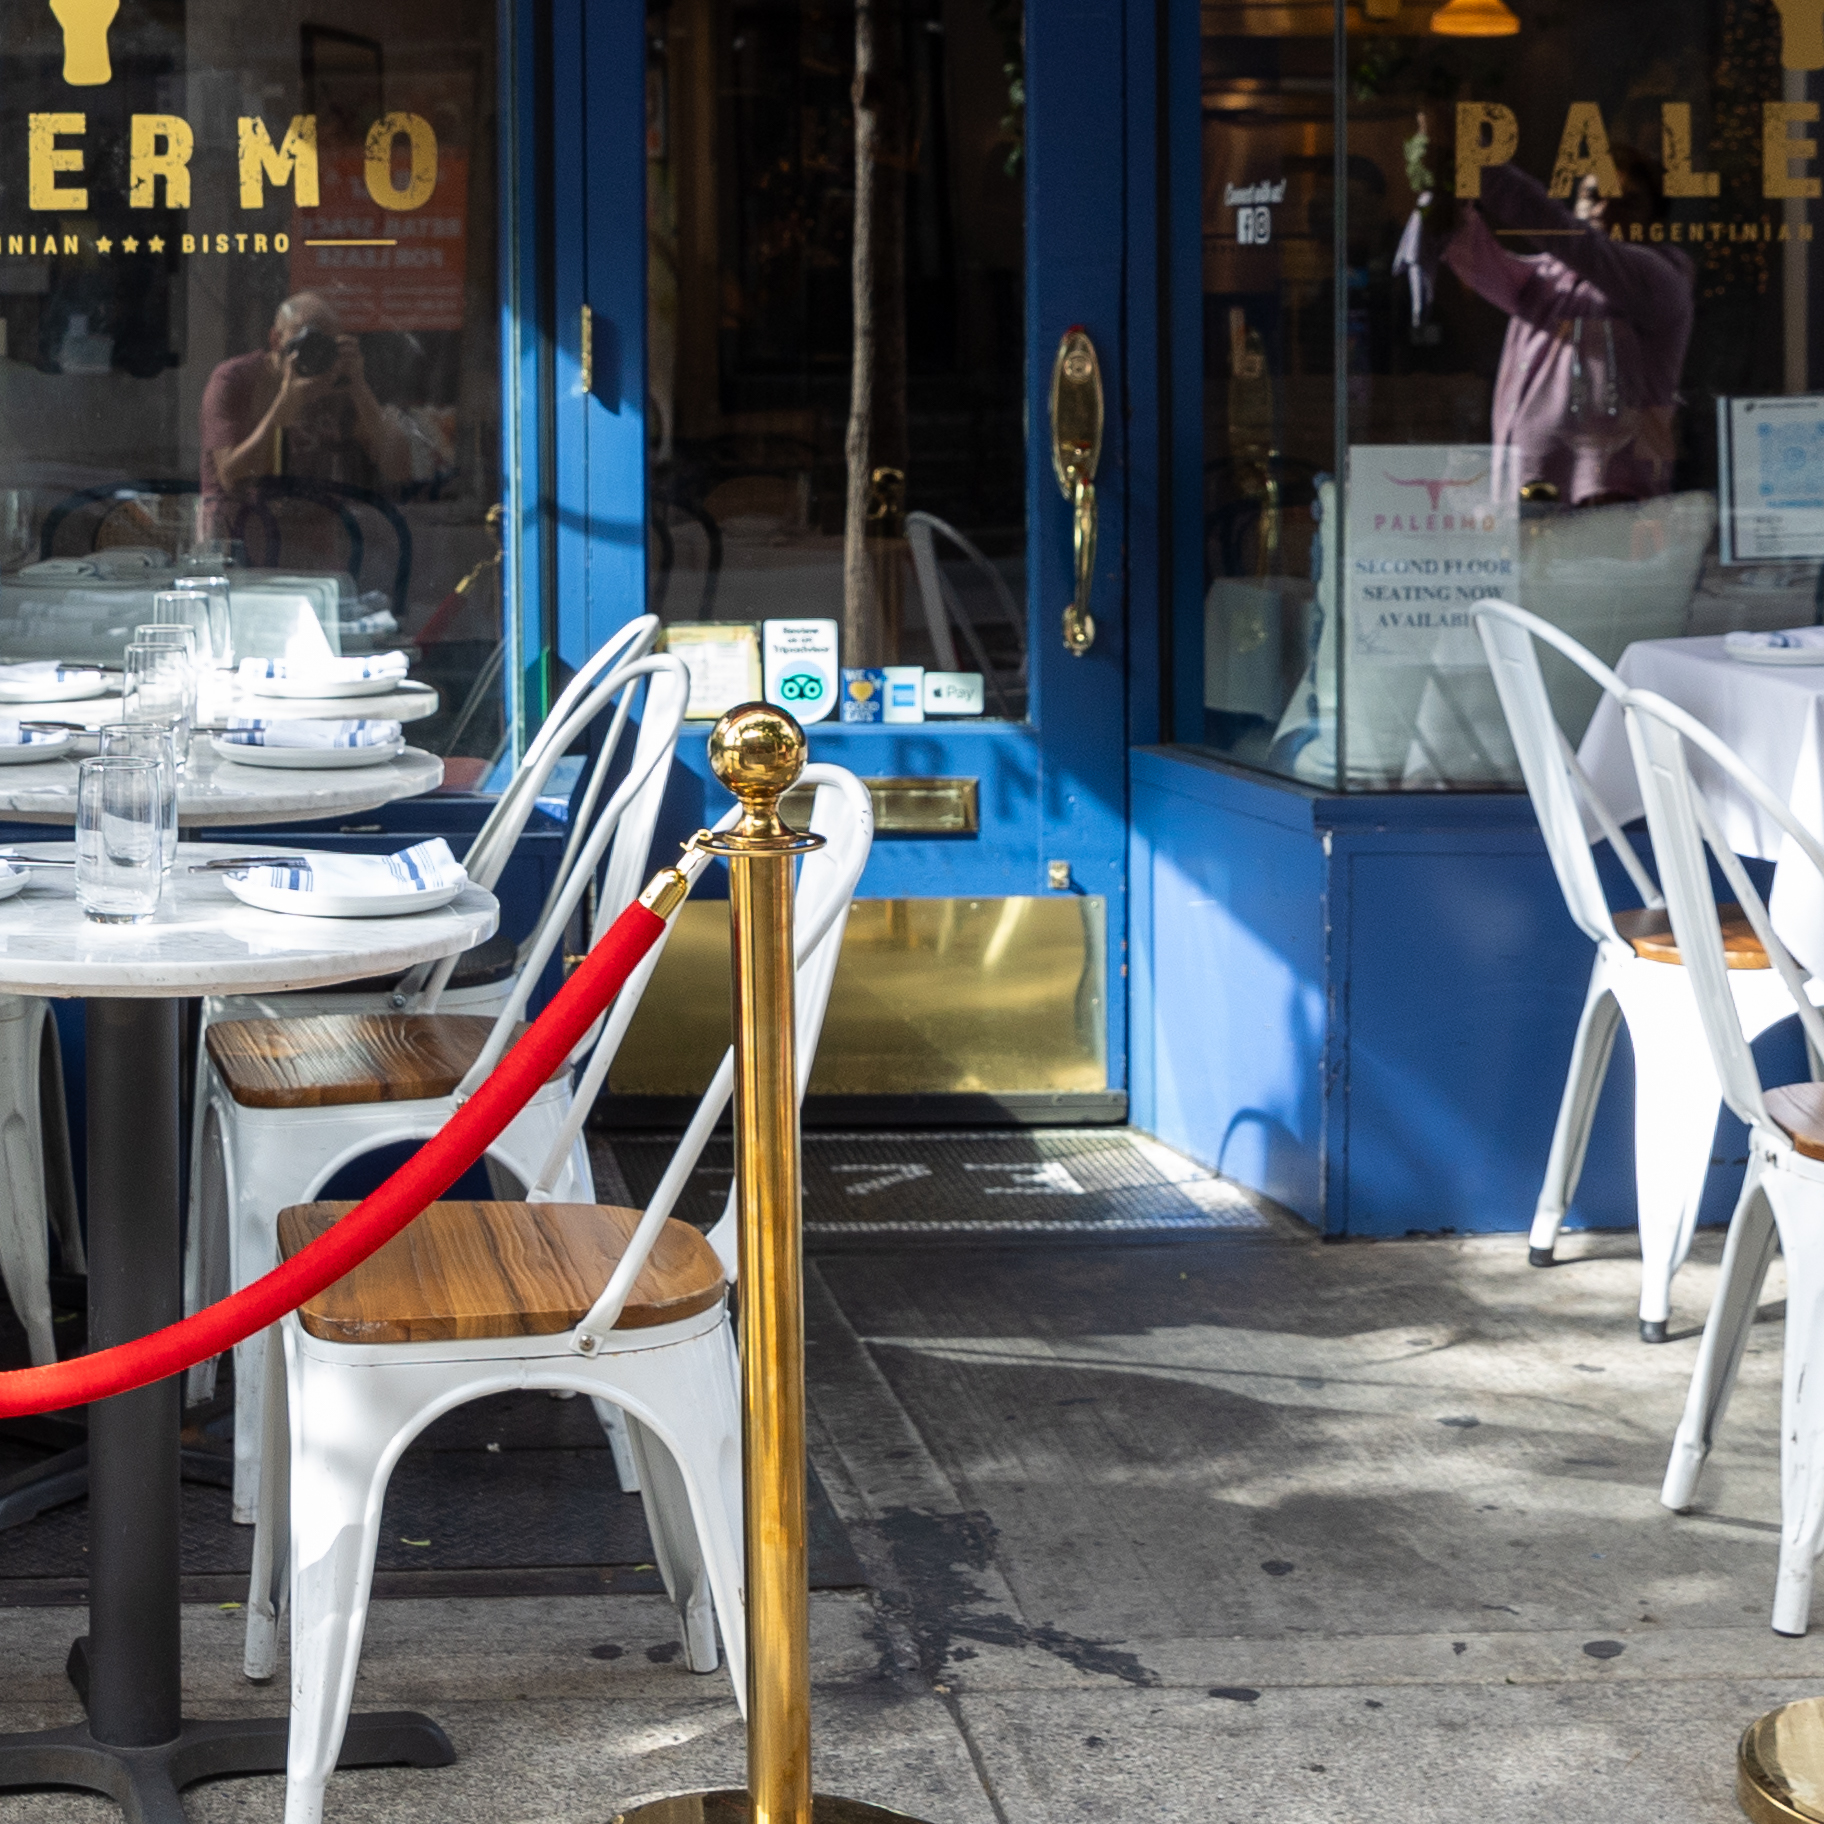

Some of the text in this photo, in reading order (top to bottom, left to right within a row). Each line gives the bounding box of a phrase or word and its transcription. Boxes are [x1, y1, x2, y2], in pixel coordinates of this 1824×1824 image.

[1608, 223, 1815, 243] ARGENTINIAN
[181, 233, 291, 254] BISTRO
[1374, 514, 1495, 532] PALERMO
[1356, 558, 1513, 575] SECOND FLOOR
[1362, 585, 1505, 601] SEATING NOW
[946, 684, 976, 702] Pay
